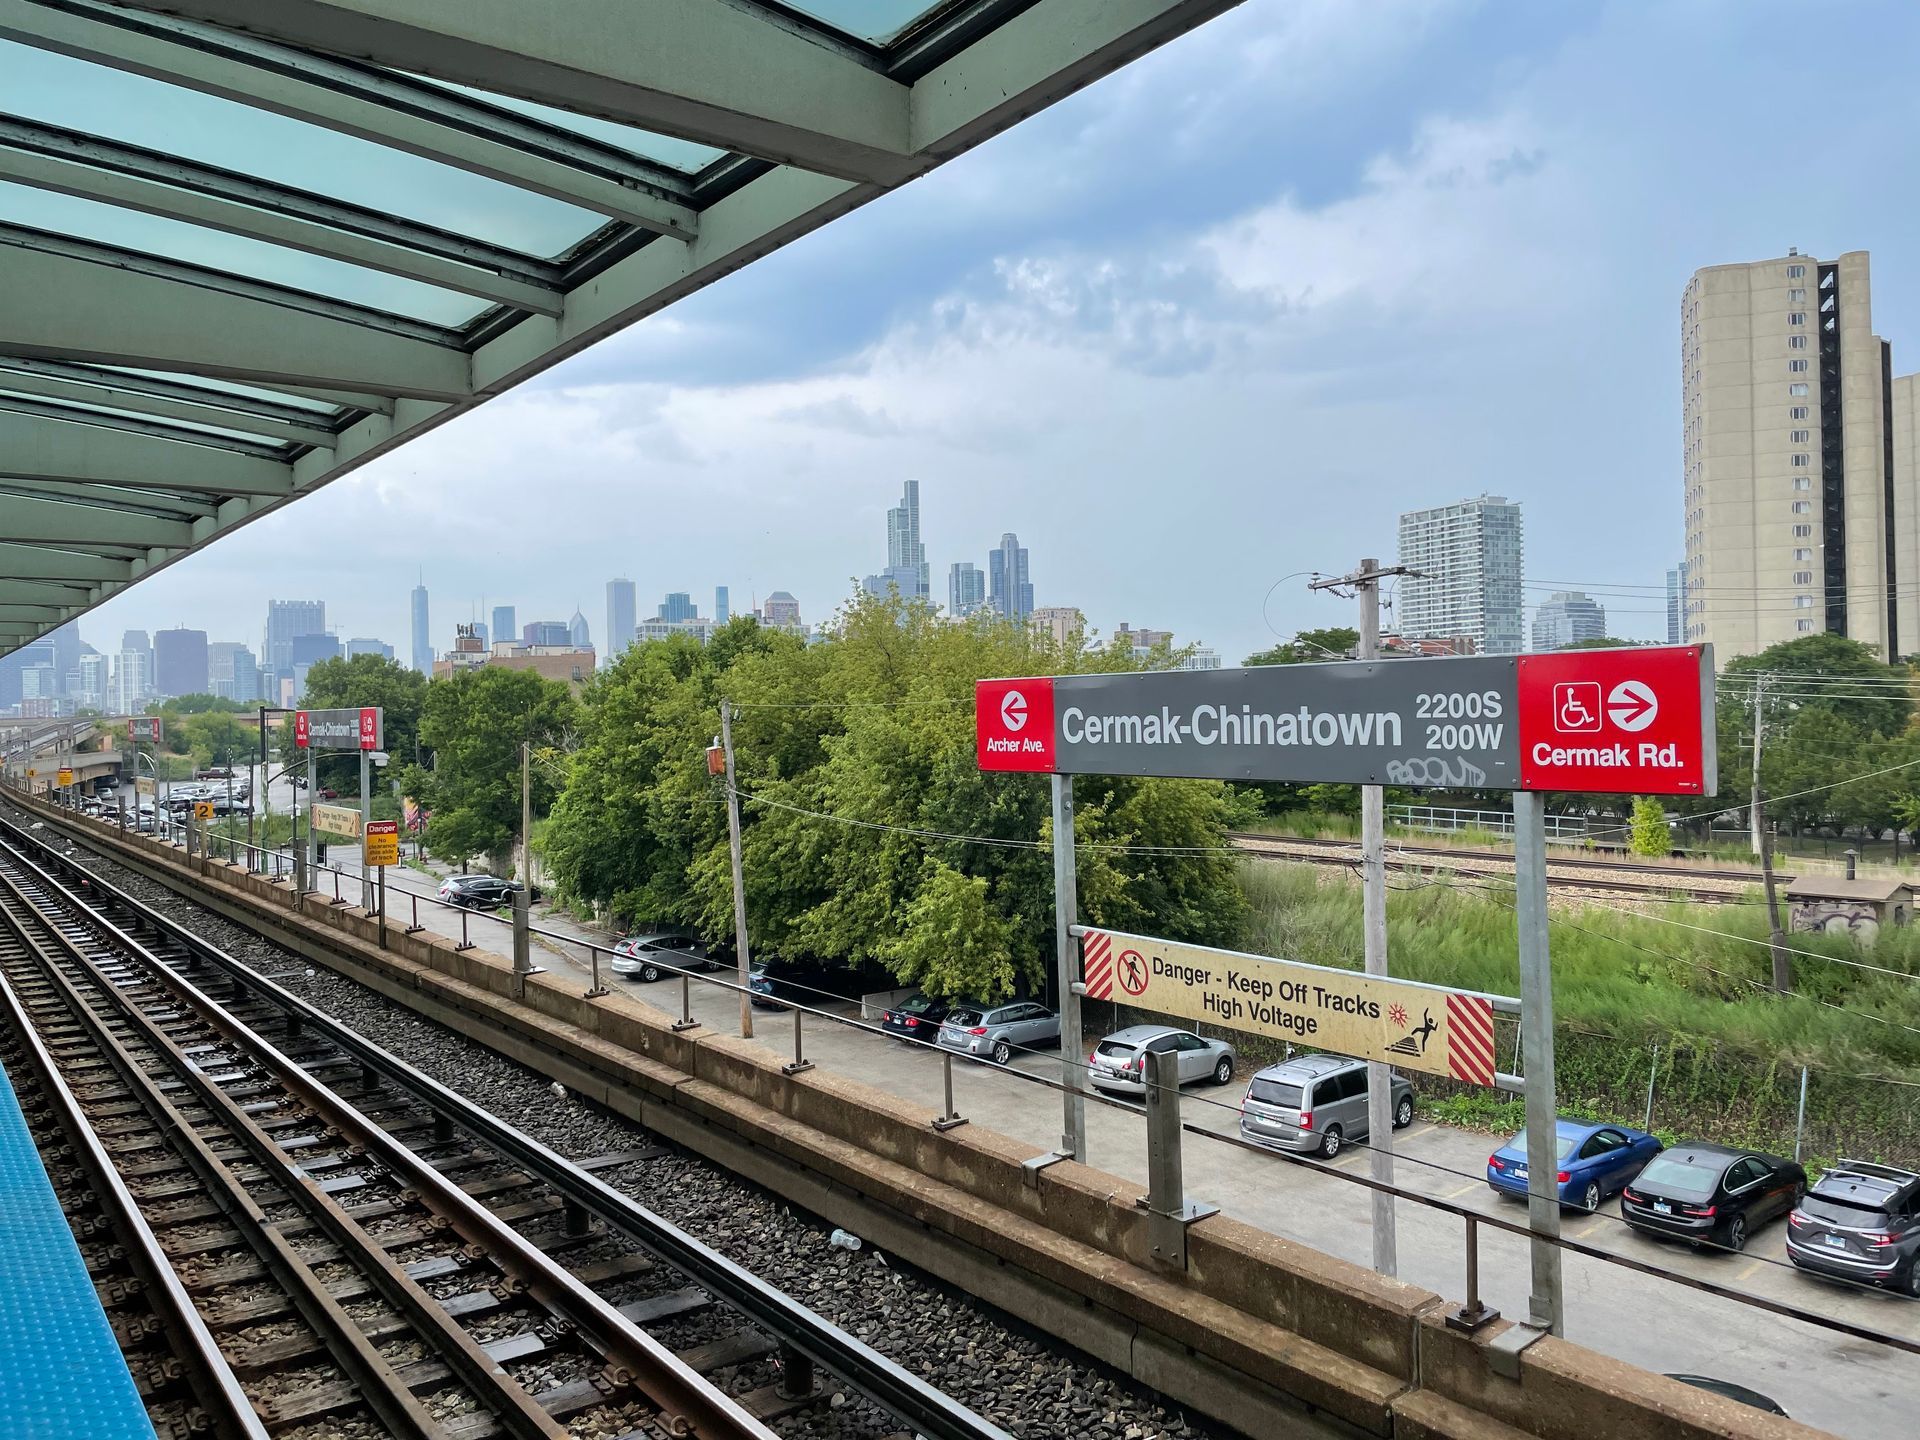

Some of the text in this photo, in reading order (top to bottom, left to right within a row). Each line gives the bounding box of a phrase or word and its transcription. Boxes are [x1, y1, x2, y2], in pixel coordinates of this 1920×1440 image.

[1415, 690, 1503, 719] 2200S
[1062, 704, 1402, 746] Cermak-Chinatown
[1425, 723, 1504, 750] 200W
[986, 737, 1045, 752] Archer Ave.
[1532, 742, 1684, 767] Cermak Rd.
[199, 805, 209, 817] 2
[368, 825, 396, 834] Danger
[1152, 956, 1211, 986] Danger
[1227, 970, 1273, 1001] Keep
[1279, 980, 1308, 1004] Off
[1312, 986, 1381, 1019] Tracks
[1203, 991, 1318, 1037] High Voltage
